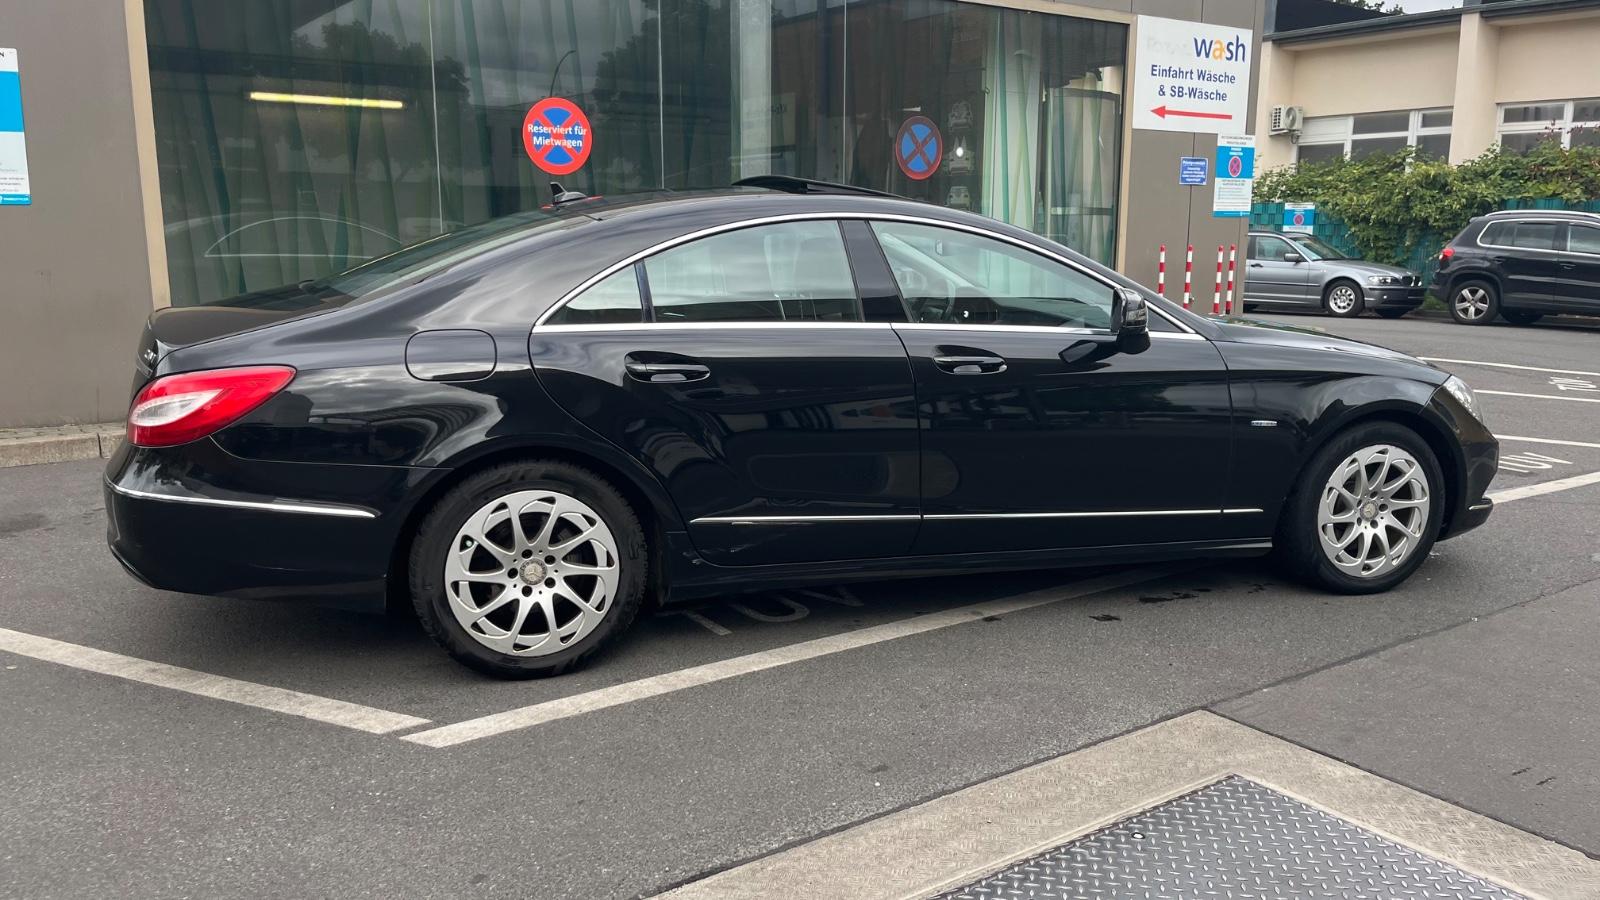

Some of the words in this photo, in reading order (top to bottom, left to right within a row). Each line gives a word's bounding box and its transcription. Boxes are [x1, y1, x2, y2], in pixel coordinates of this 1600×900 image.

[1193, 34, 1246, 63] wash
[1151, 64, 1194, 80] Einfahrt
[1197, 69, 1236, 84] Wäsche
[1158, 84, 1166, 97] &
[1170, 85, 1228, 101] SB-Wäsche
[527, 123, 573, 135] Reserviert
[574, 125, 588, 136] für
[533, 137, 583, 148] Mietwagen
